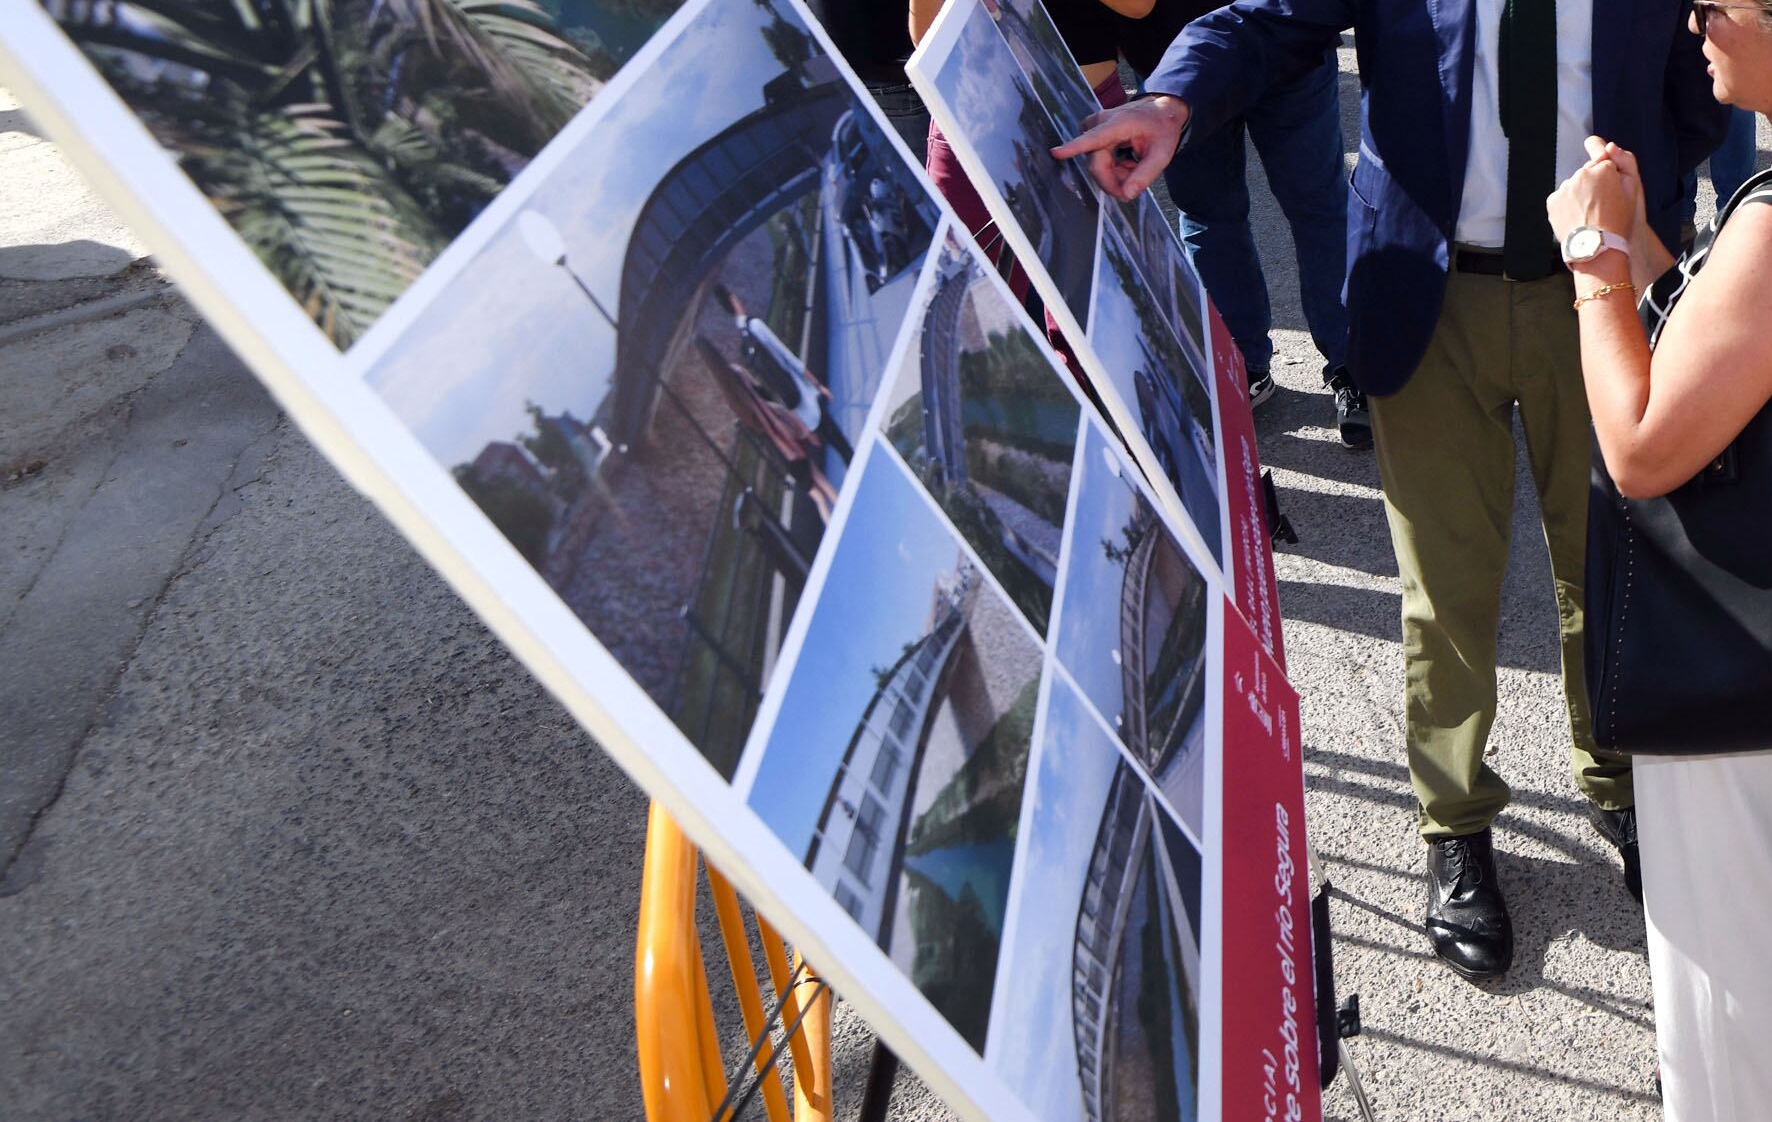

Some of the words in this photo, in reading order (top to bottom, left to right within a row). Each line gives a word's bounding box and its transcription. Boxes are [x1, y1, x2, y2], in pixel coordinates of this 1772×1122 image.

[1275, 802, 1295, 907] Segura
[1275, 904, 1295, 952] río
[1276, 942, 1296, 986] el
[1279, 986, 1301, 1094] sobre
